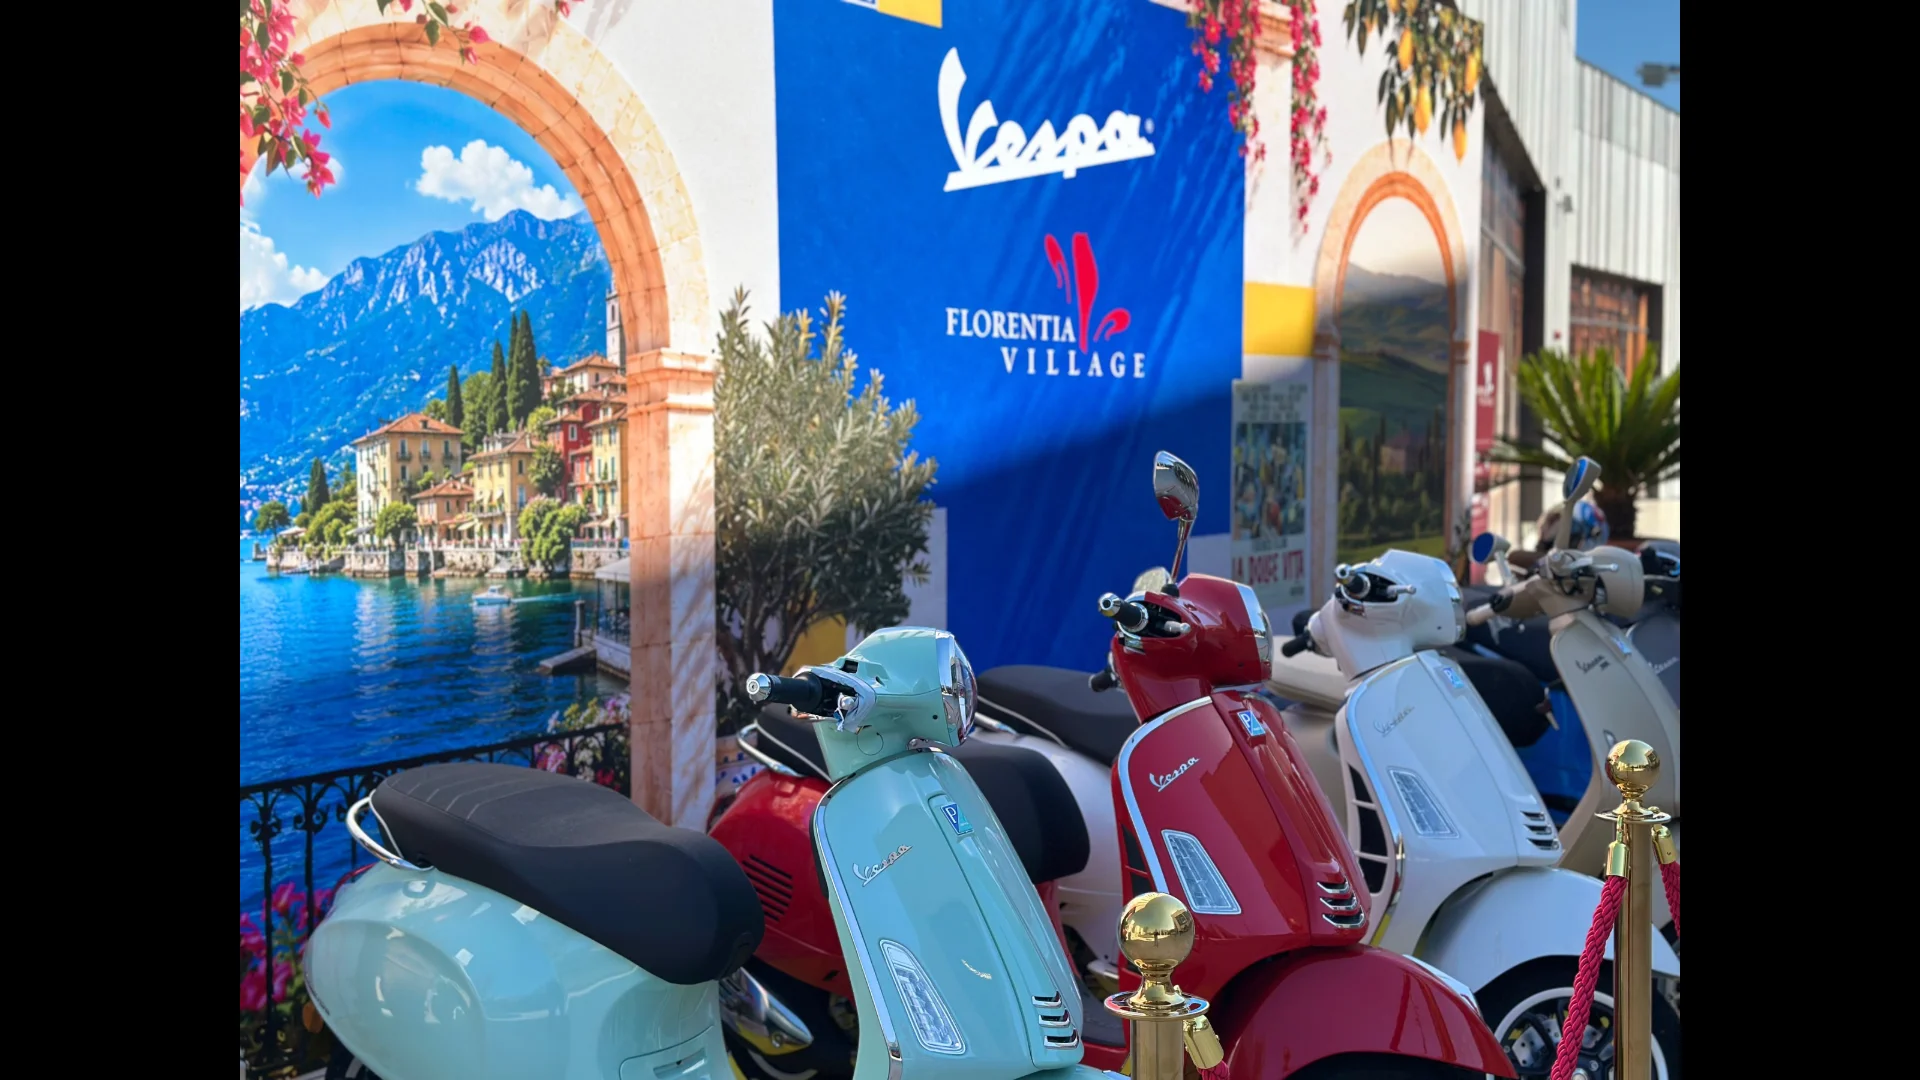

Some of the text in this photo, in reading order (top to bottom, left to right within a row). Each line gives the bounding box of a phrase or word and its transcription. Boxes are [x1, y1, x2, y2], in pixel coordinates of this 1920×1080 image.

[938, 47, 1155, 192] Vespa
[946, 307, 1076, 343] FLORENTIA
[1001, 347, 1145, 378] VILLAGE
[1149, 756, 1200, 792] Vespa
[945, 806, 957, 824] P
[852, 844, 913, 887] Vespa
